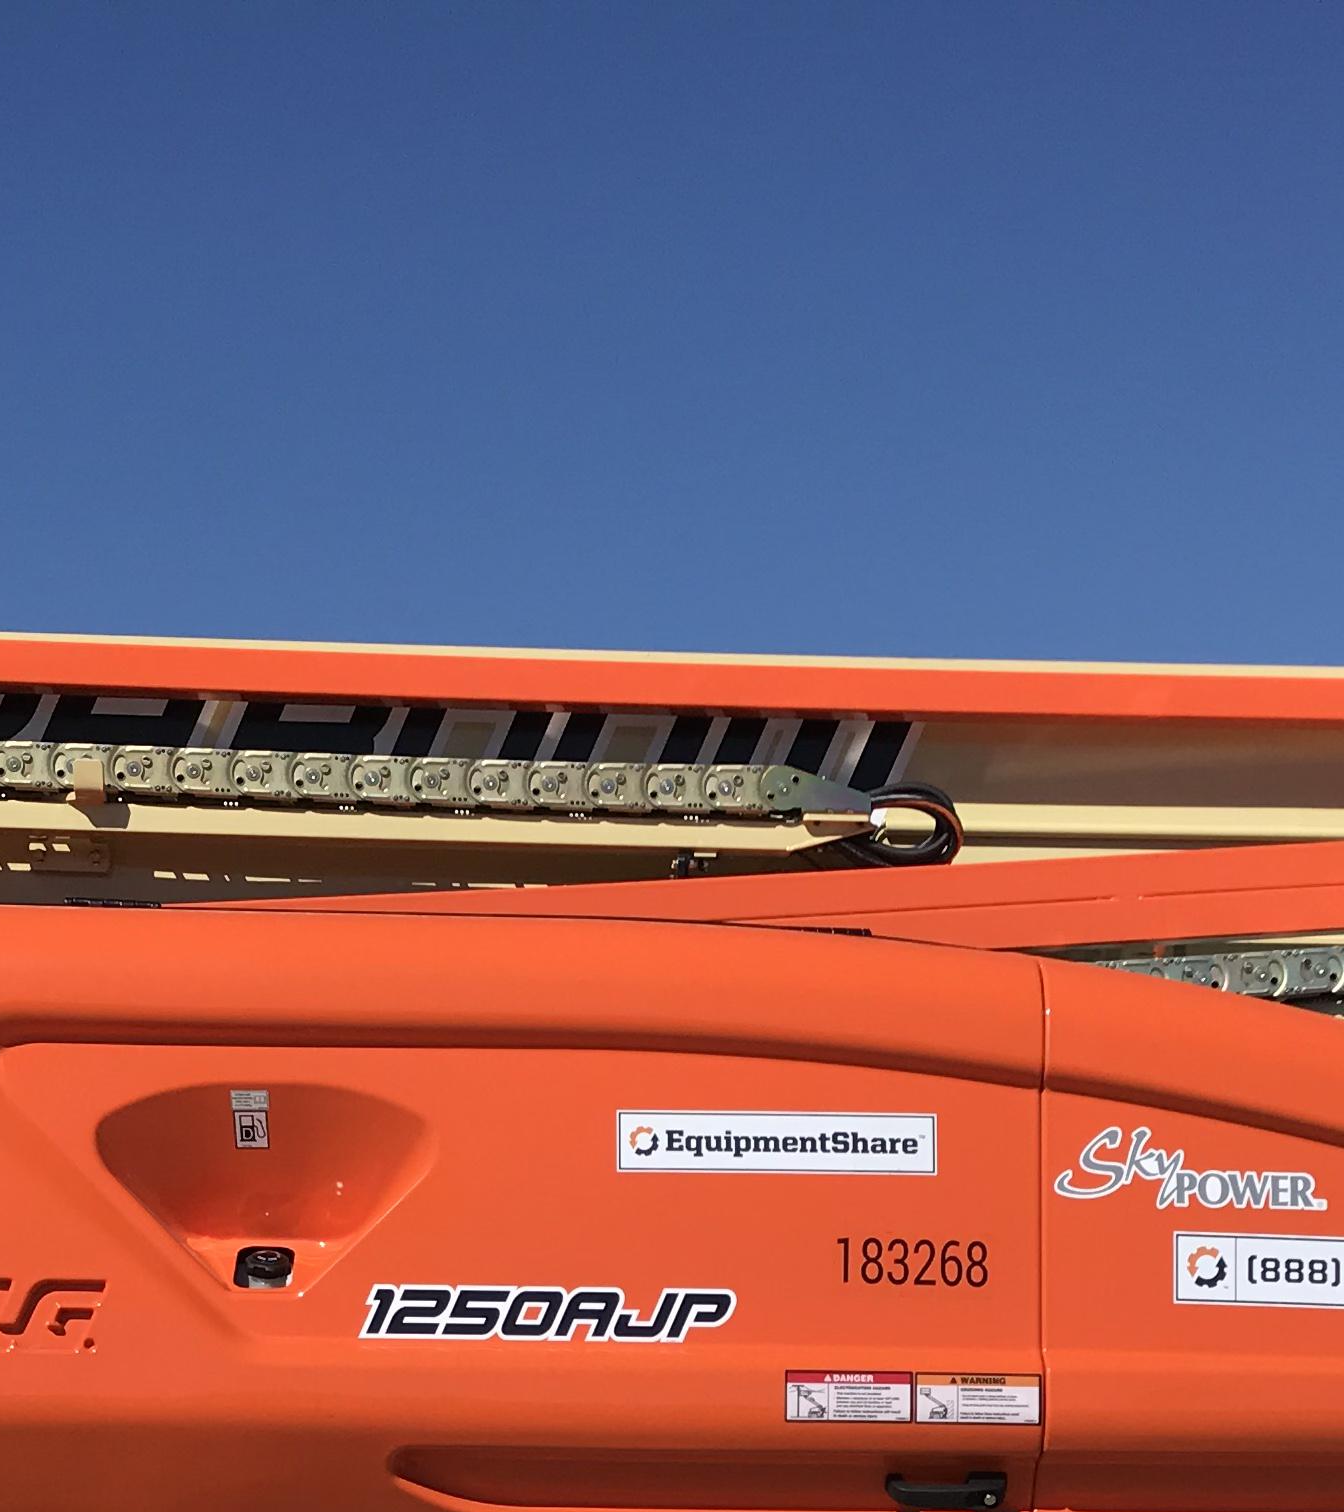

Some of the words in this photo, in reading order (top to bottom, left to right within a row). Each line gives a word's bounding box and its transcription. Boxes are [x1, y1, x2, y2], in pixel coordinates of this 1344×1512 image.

[666, 1130, 918, 1158] EquipmentShare
[1176, 1172, 1315, 1208] POWER
[836, 1237, 989, 1288] 183268
[1247, 1255, 1341, 1288] (888)
[363, 1286, 735, 1341] 1250AJP
[832, 1374, 874, 1383] DANGER
[960, 1377, 1006, 1385] WARNING
